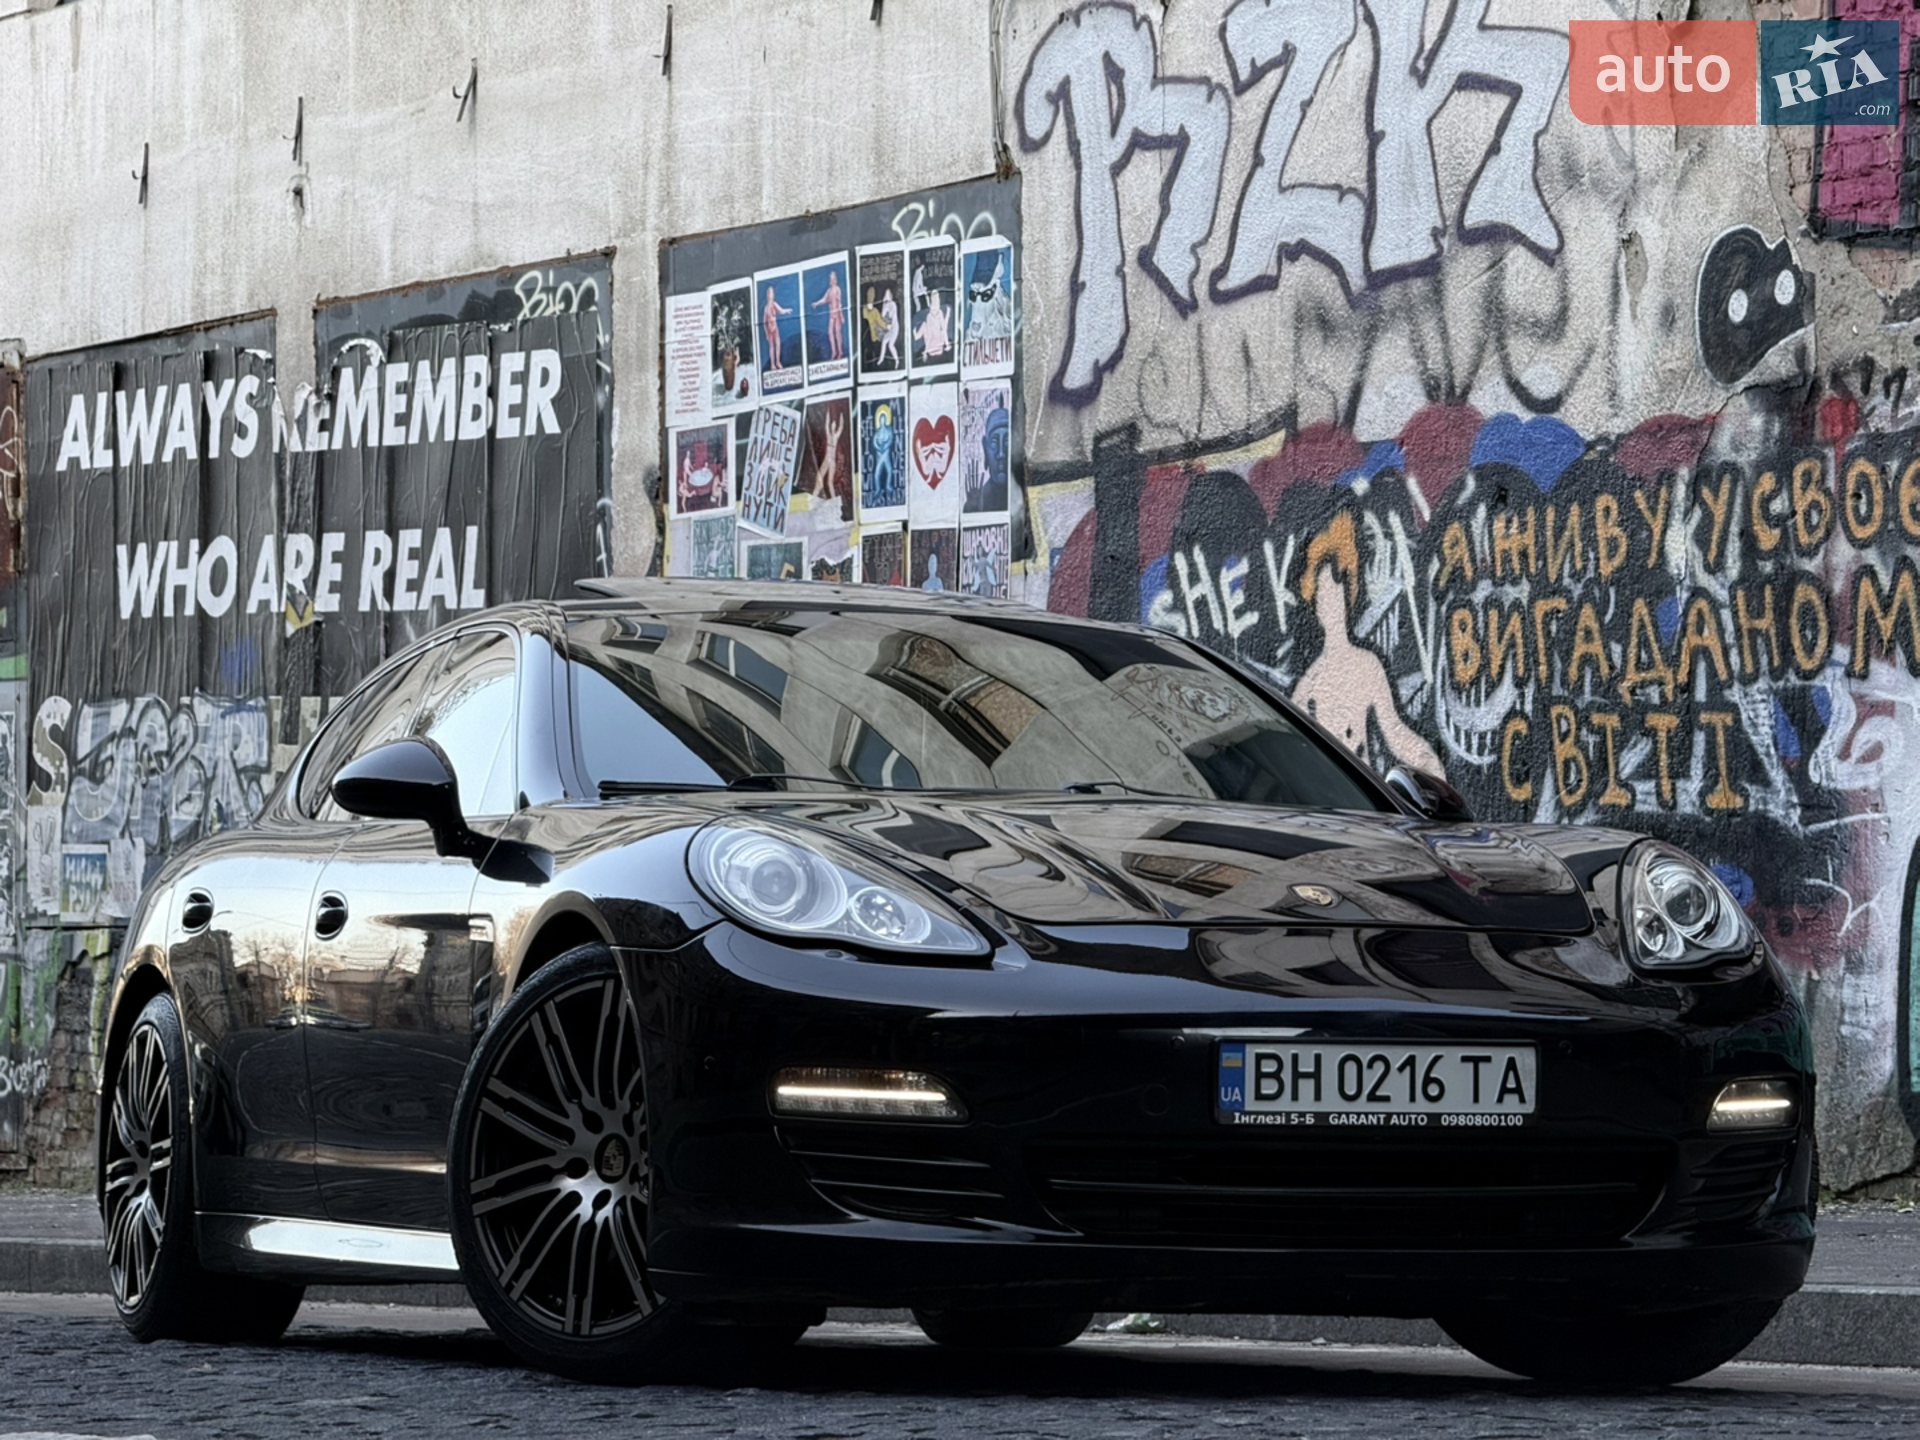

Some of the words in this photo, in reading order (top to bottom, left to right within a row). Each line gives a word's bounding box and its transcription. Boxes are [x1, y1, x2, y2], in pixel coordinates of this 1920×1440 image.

[56, 374, 261, 472] ALWAYS
[1493, 484, 1668, 584] ЖИВУ
[116, 535, 238, 619] WHO
[246, 532, 345, 614] ARE
[358, 525, 486, 612] REAL
[1503, 704, 1745, 810] СВІТІ
[1221, 1086, 1242, 1102] UA
[1254, 1051, 1322, 1102] BH
[1337, 1053, 1445, 1103] 0216
[1460, 1055, 1526, 1104] TA
[1233, 1112, 1286, 1125] Інглезі
[1290, 1113, 1315, 1125] 5-Б
[1328, 1113, 1386, 1125] GARANT
[1390, 1114, 1428, 1126] AUTO
[1441, 1114, 1523, 1126] 0980800100
